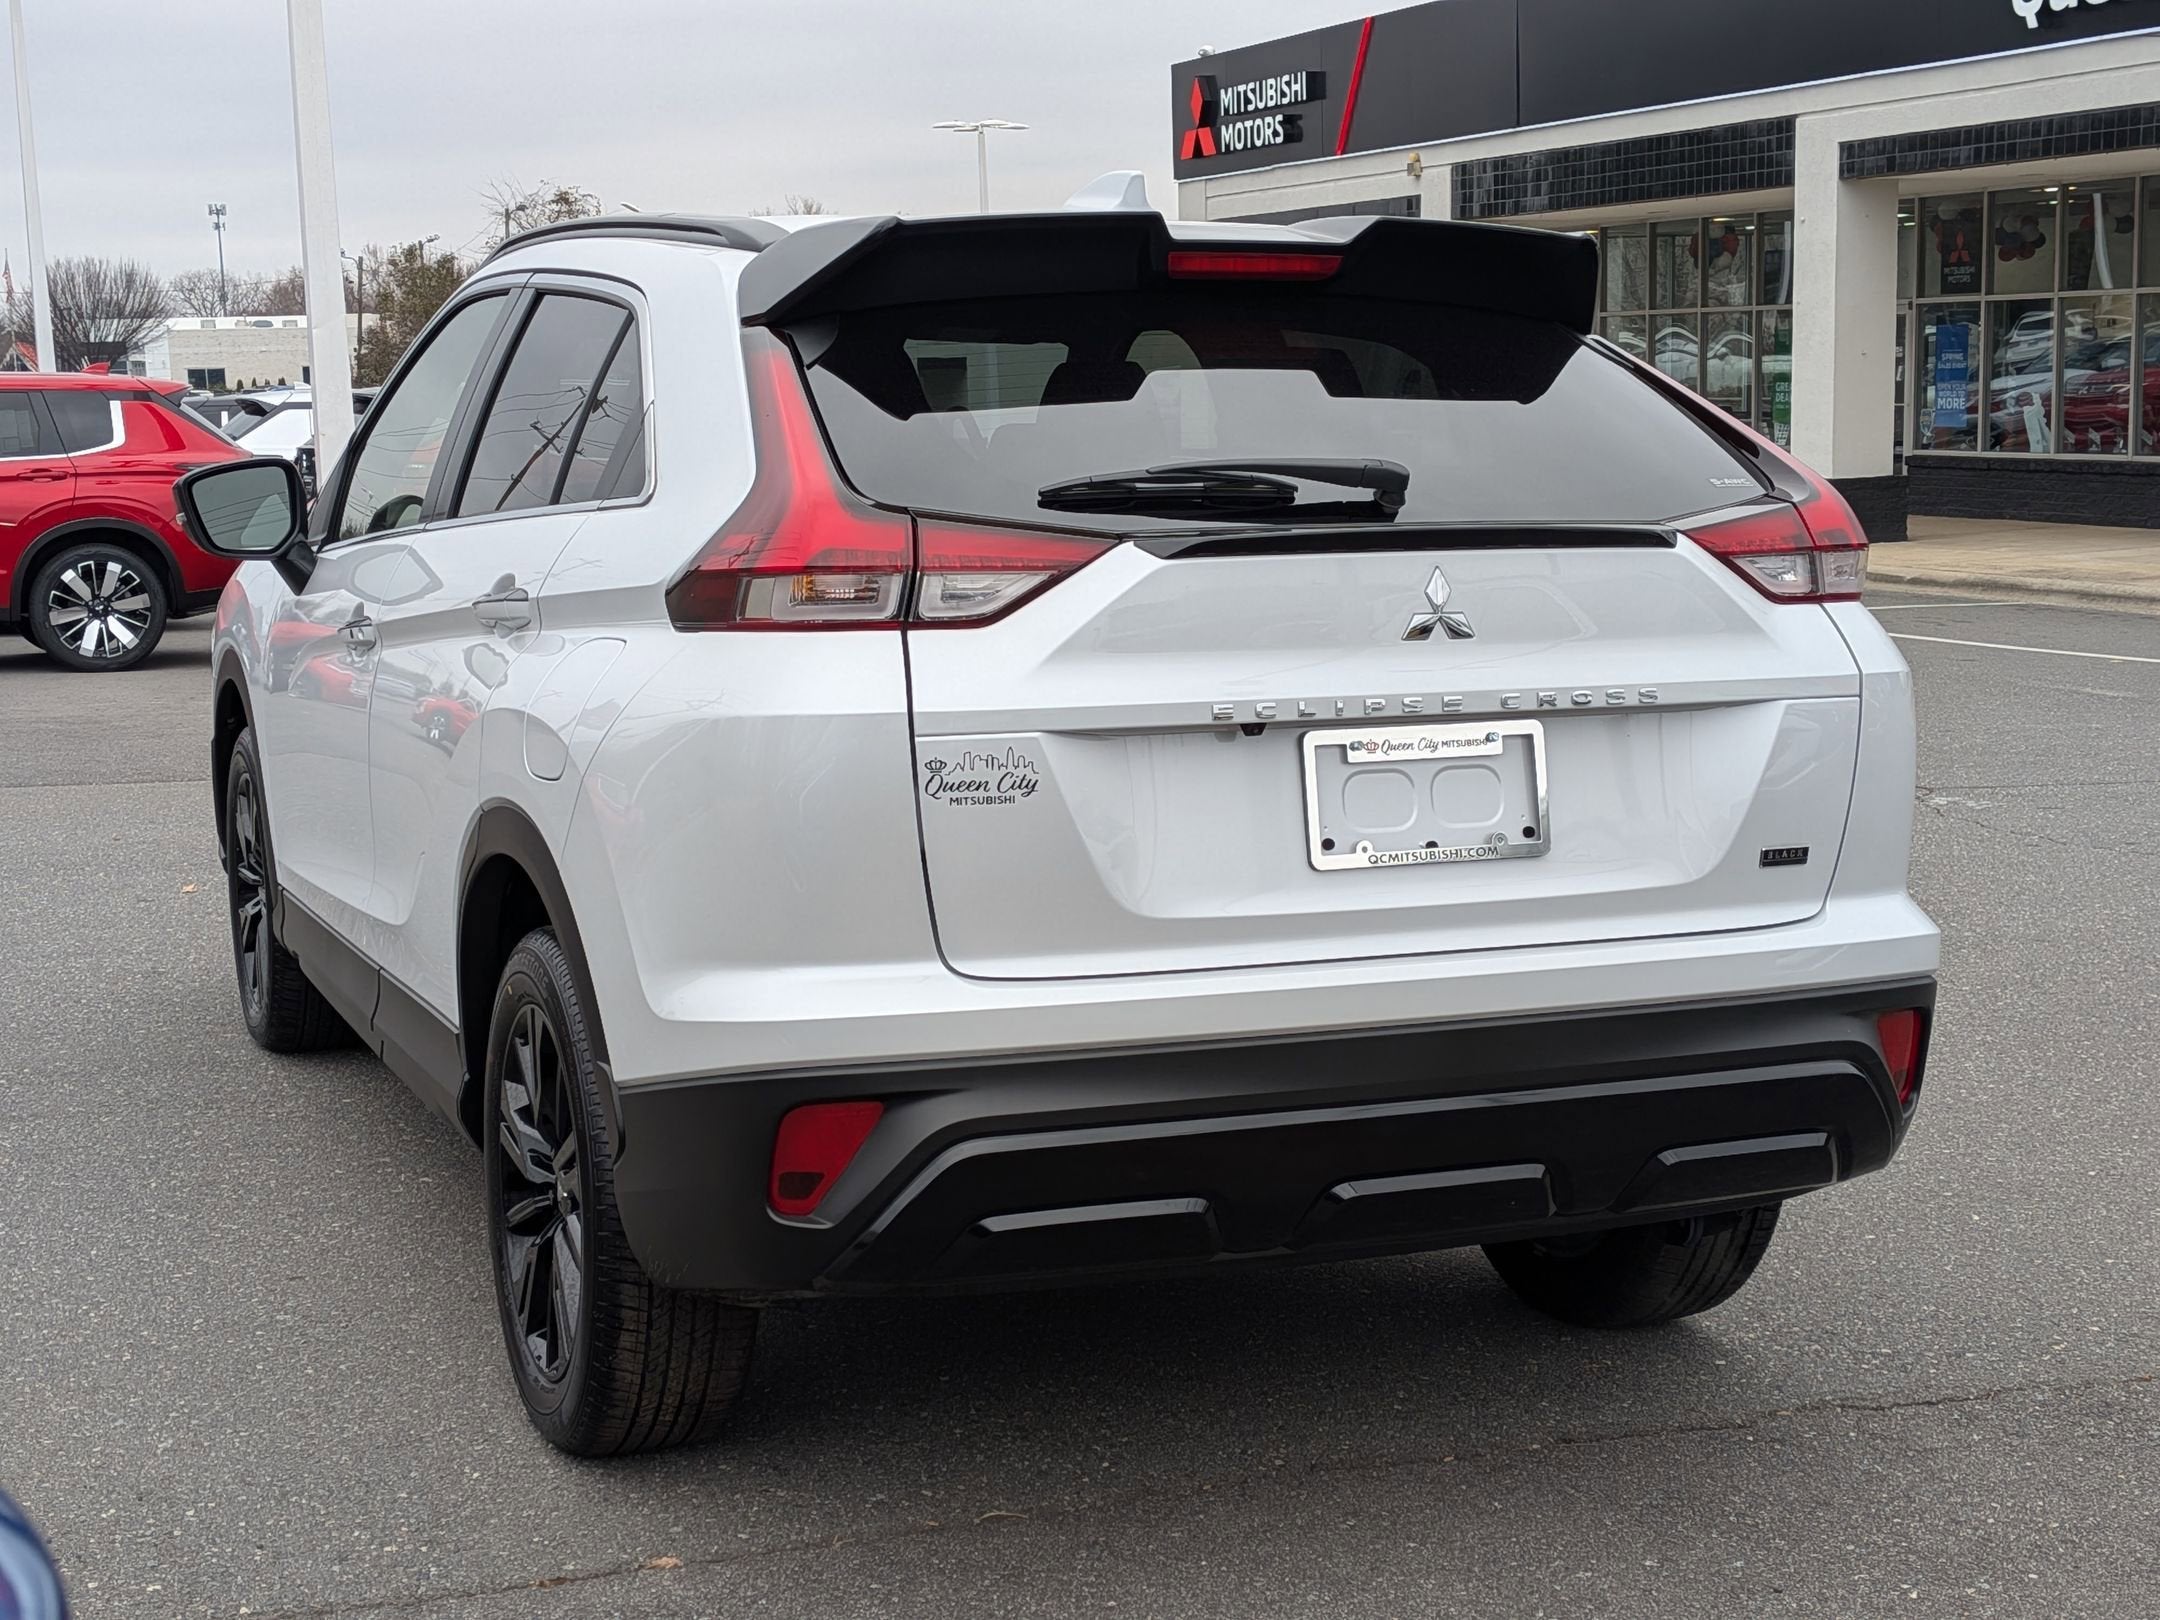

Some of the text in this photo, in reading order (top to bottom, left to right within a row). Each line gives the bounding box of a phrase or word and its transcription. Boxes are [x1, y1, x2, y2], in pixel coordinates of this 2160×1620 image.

[1220, 71, 1307, 116] MITSUBISHI
[1221, 114, 1284, 152] MOTORS
[1937, 398, 1966, 410] MORE
[1211, 687, 1659, 721] ECLIPSE CROSS
[1381, 739, 1415, 755] Queen
[1418, 737, 1439, 753] City
[924, 771, 1040, 800] Queen City
[949, 795, 1016, 806] MITSUBISHI
[1368, 847, 1499, 864] QCMITSUBISHI.COM
[1766, 848, 1804, 859] BLACK
